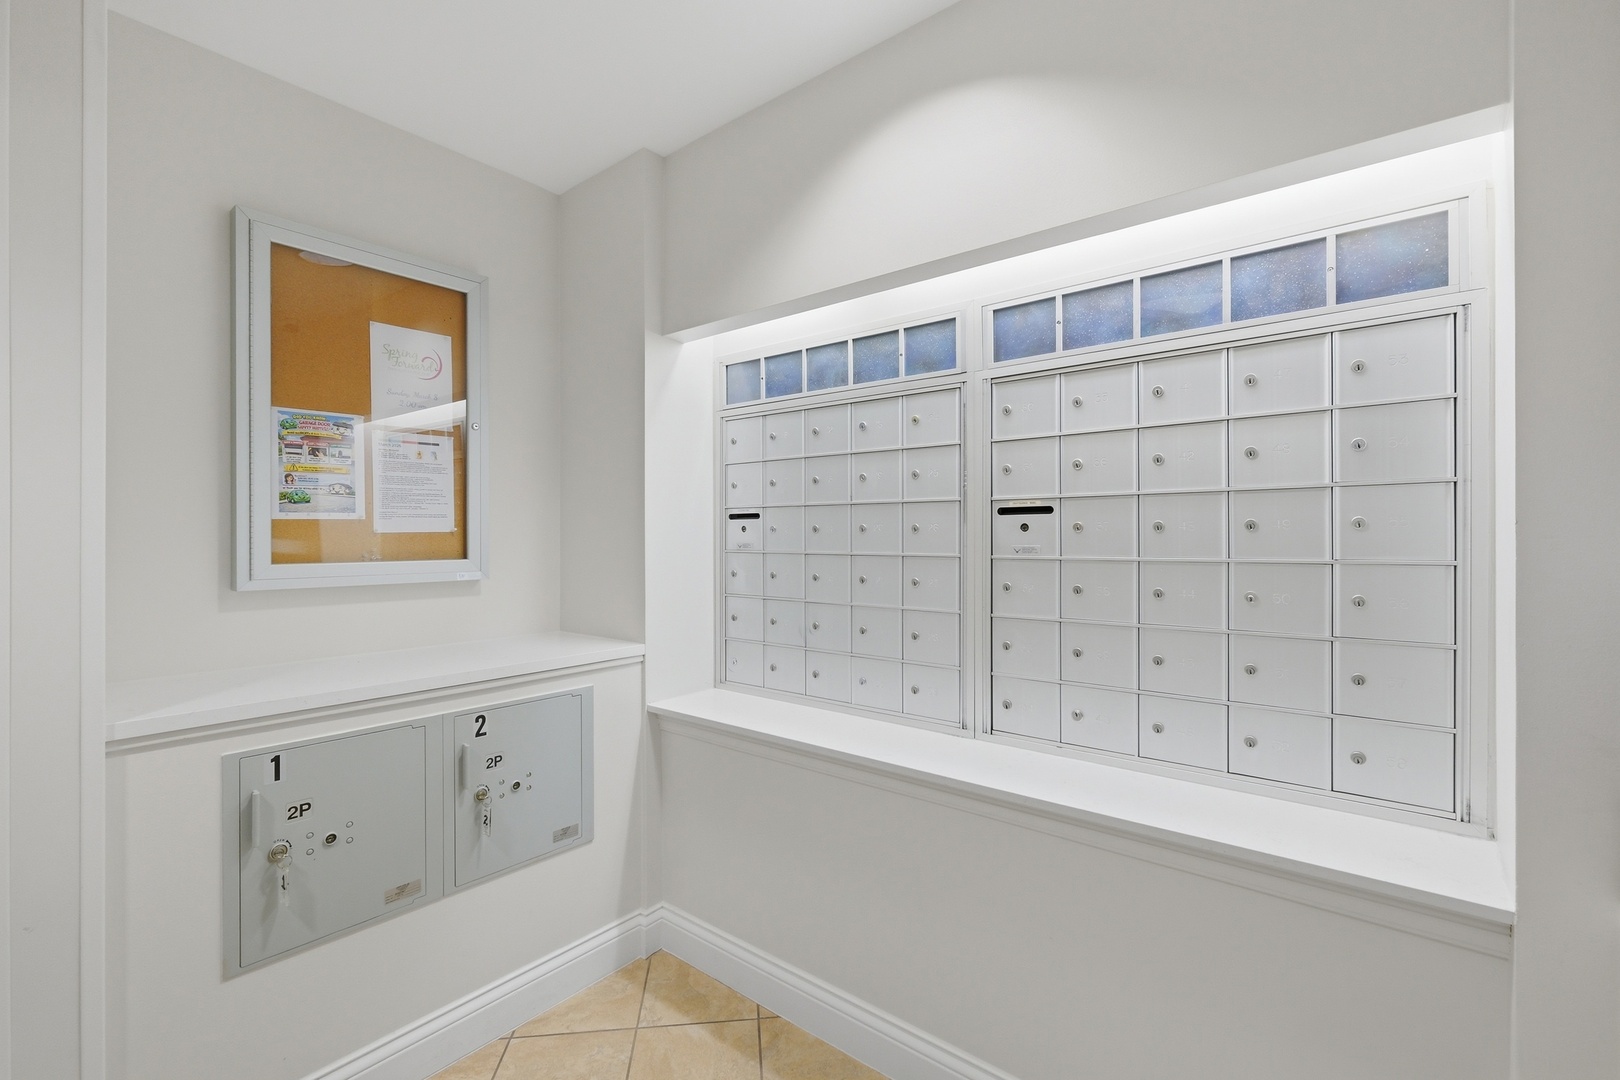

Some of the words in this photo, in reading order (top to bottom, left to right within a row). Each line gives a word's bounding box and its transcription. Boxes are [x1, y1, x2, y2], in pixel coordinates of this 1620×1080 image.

[381, 343, 418, 363] Spring
[1388, 353, 1409, 368] 53
[475, 714, 487, 738] 2
[270, 754, 281, 782] 1
[486, 754, 503, 770] 2P
[287, 802, 312, 821] 2P
